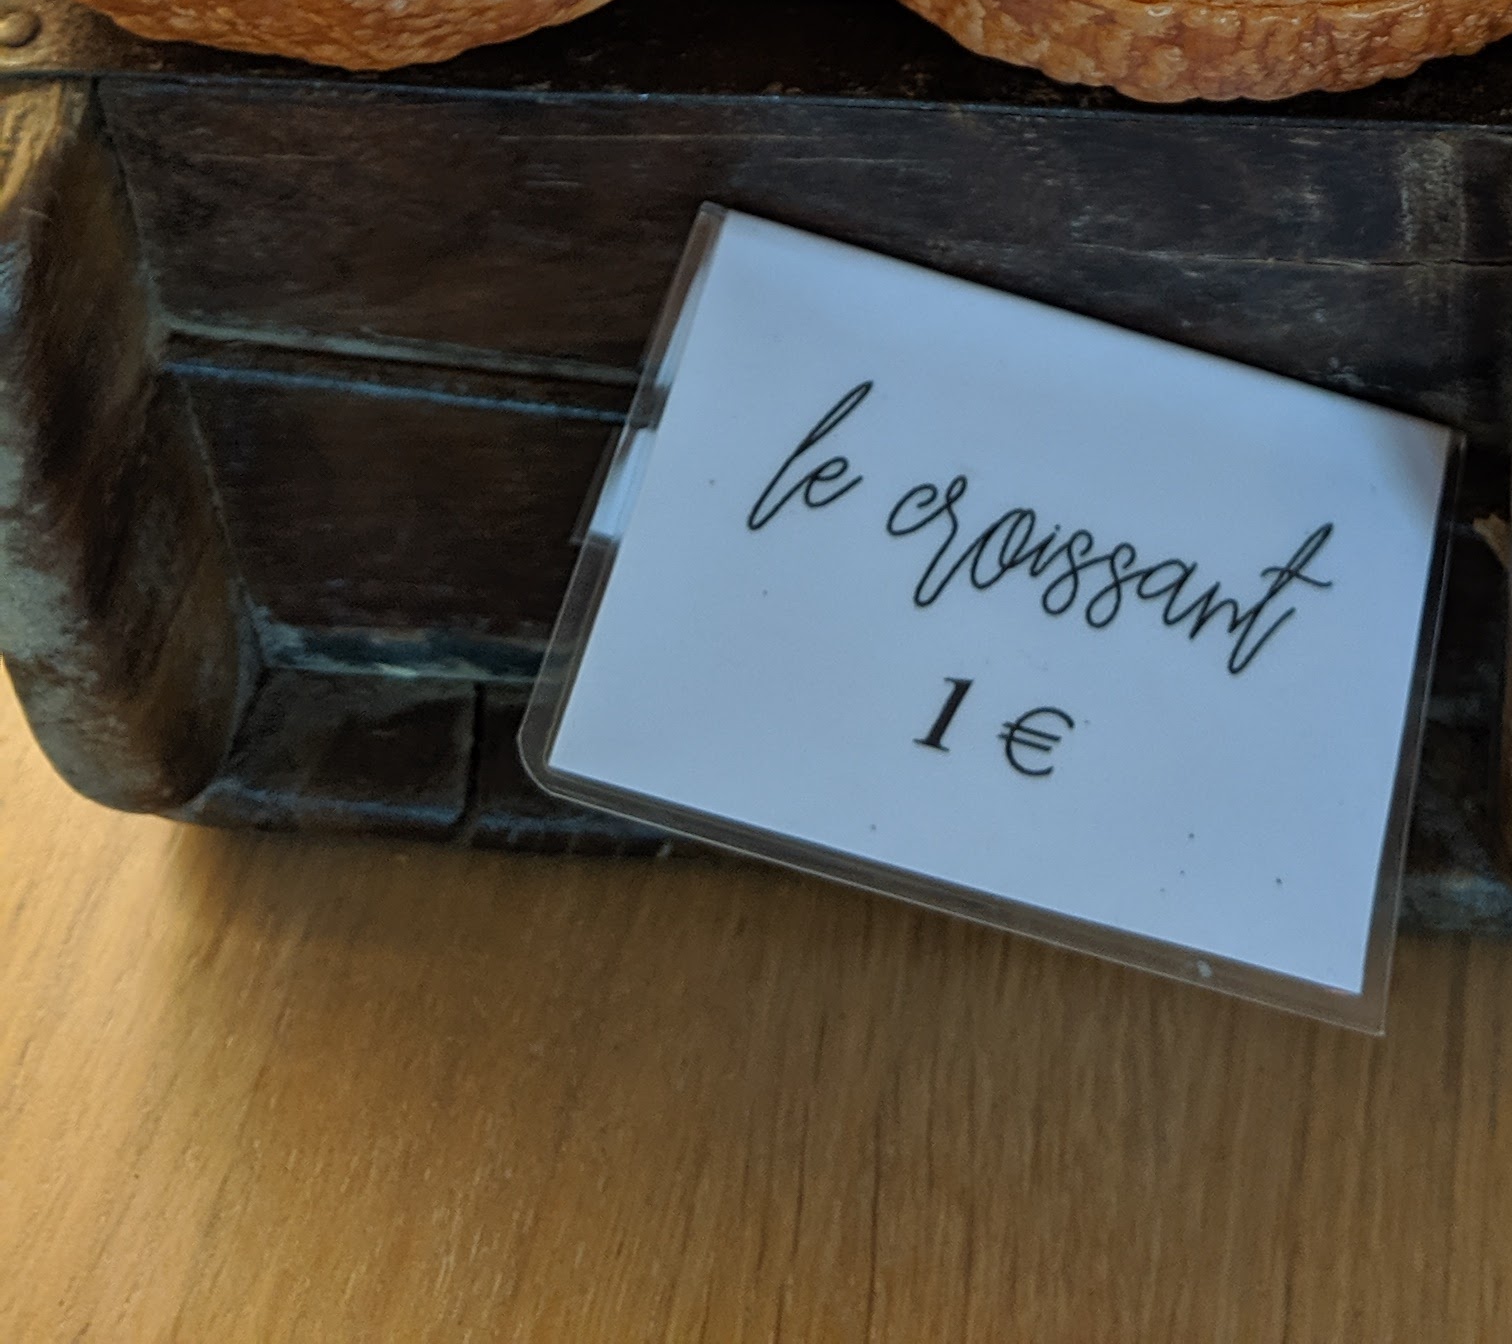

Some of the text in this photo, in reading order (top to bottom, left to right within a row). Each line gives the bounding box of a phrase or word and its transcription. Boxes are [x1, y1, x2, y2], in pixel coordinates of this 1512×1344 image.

[745, 379, 1336, 678] le croissant
[911, 675, 1077, 779] 1 €
